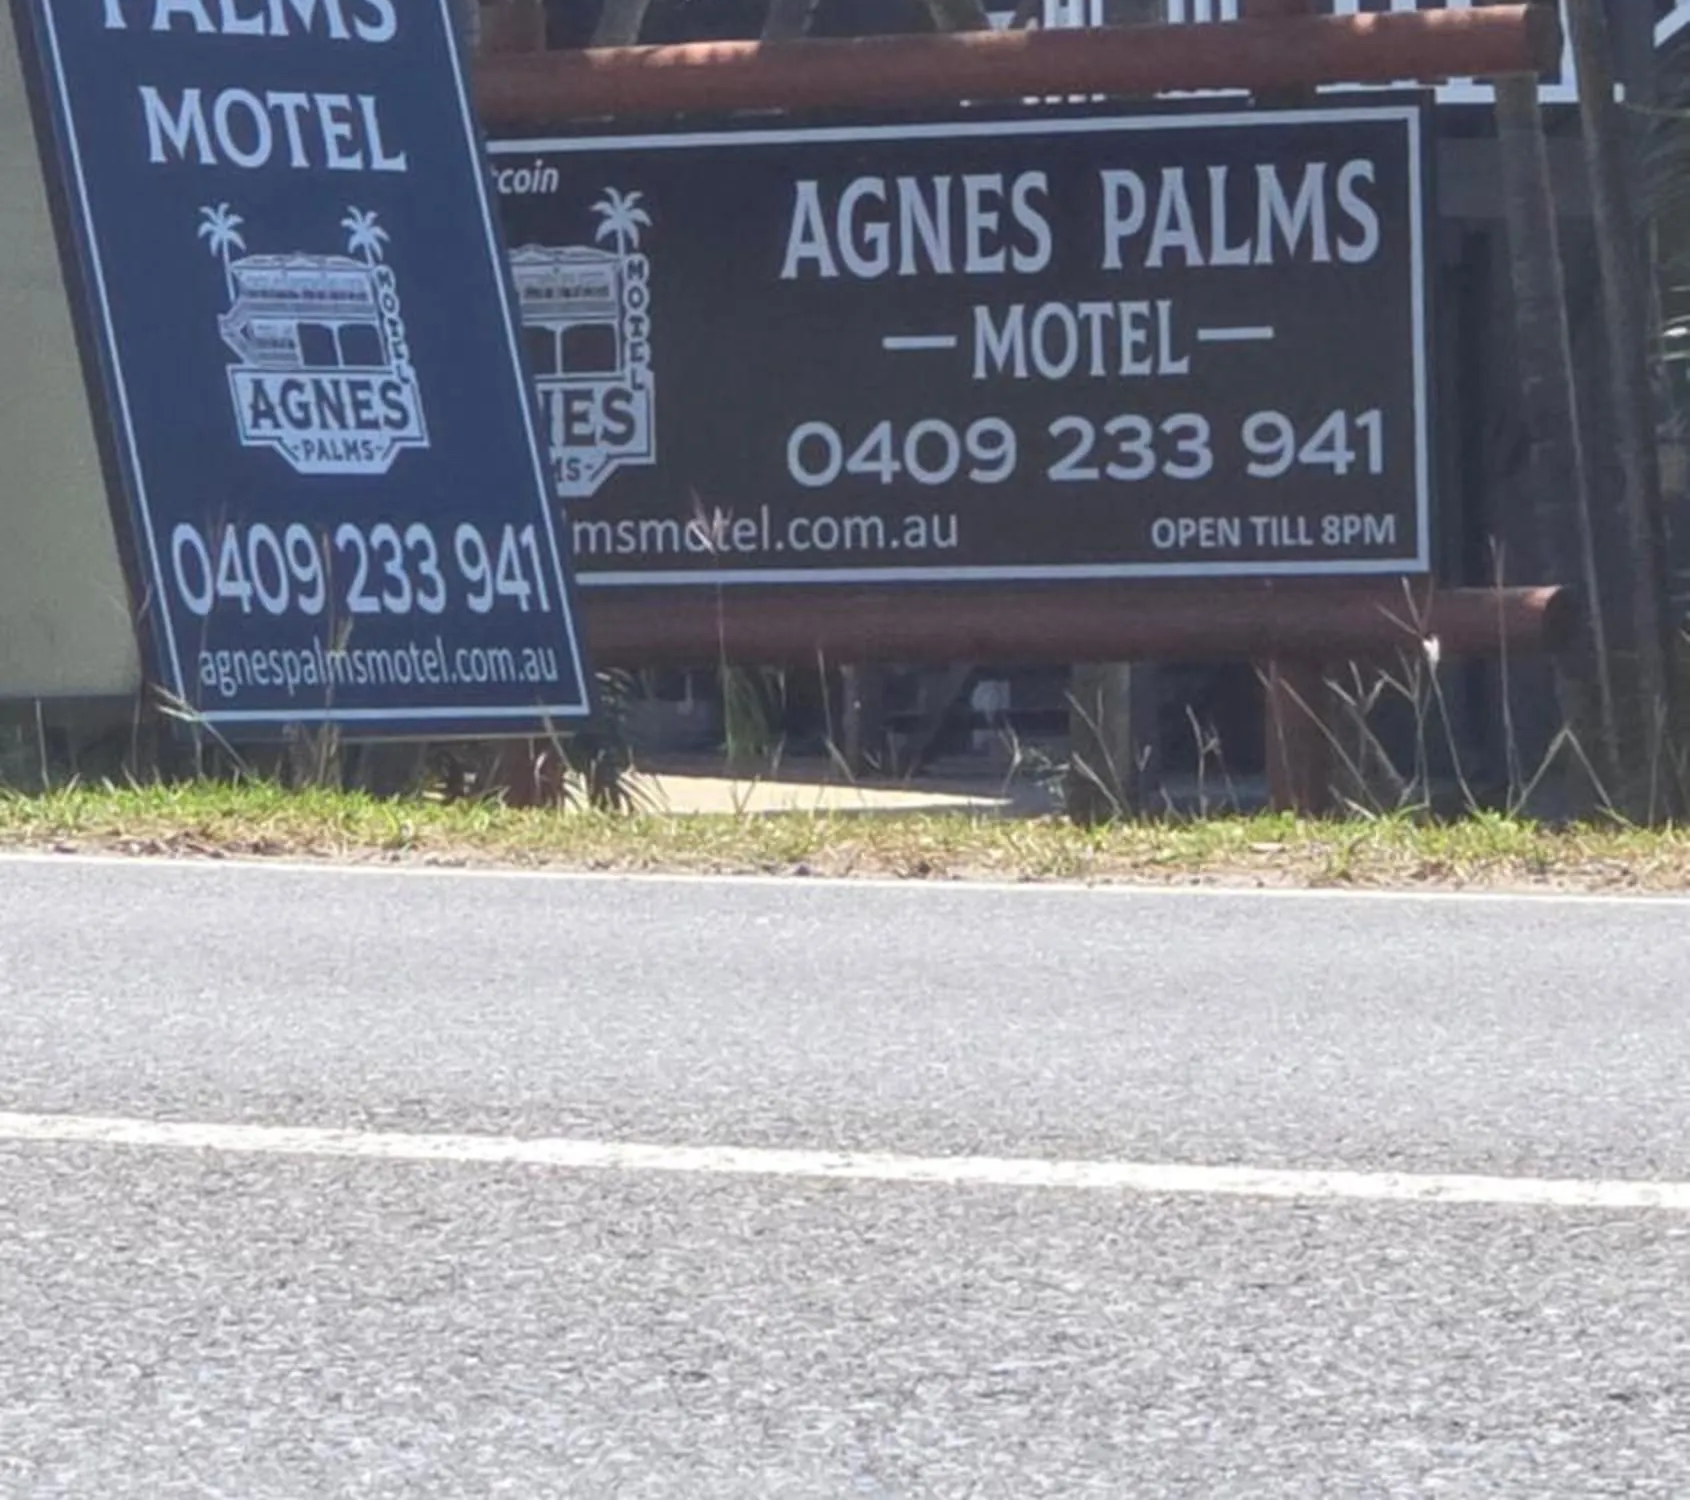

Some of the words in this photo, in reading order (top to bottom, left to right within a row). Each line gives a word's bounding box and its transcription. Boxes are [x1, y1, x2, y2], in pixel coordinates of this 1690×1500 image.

[138, 86, 407, 172] MOTEL
[490, 158, 560, 194] coin
[780, 170, 1053, 279] AGNES
[1100, 158, 1380, 270] PALMS
[972, 299, 1189, 380] MOTEL
[249, 377, 411, 431] AGNES
[786, 416, 1018, 487] 0409
[1048, 412, 1215, 482] 233
[1241, 409, 1383, 478] 941
[562, 504, 958, 554] msmotel.com.au
[1152, 516, 1241, 549] OPEN
[1249, 514, 1314, 547] TILL
[1321, 513, 1396, 546] 8PM
[172, 522, 327, 616] 0409
[335, 522, 446, 615] 233
[454, 522, 551, 614] 941
[199, 635, 560, 698] agnespalmsmotel.com.au
